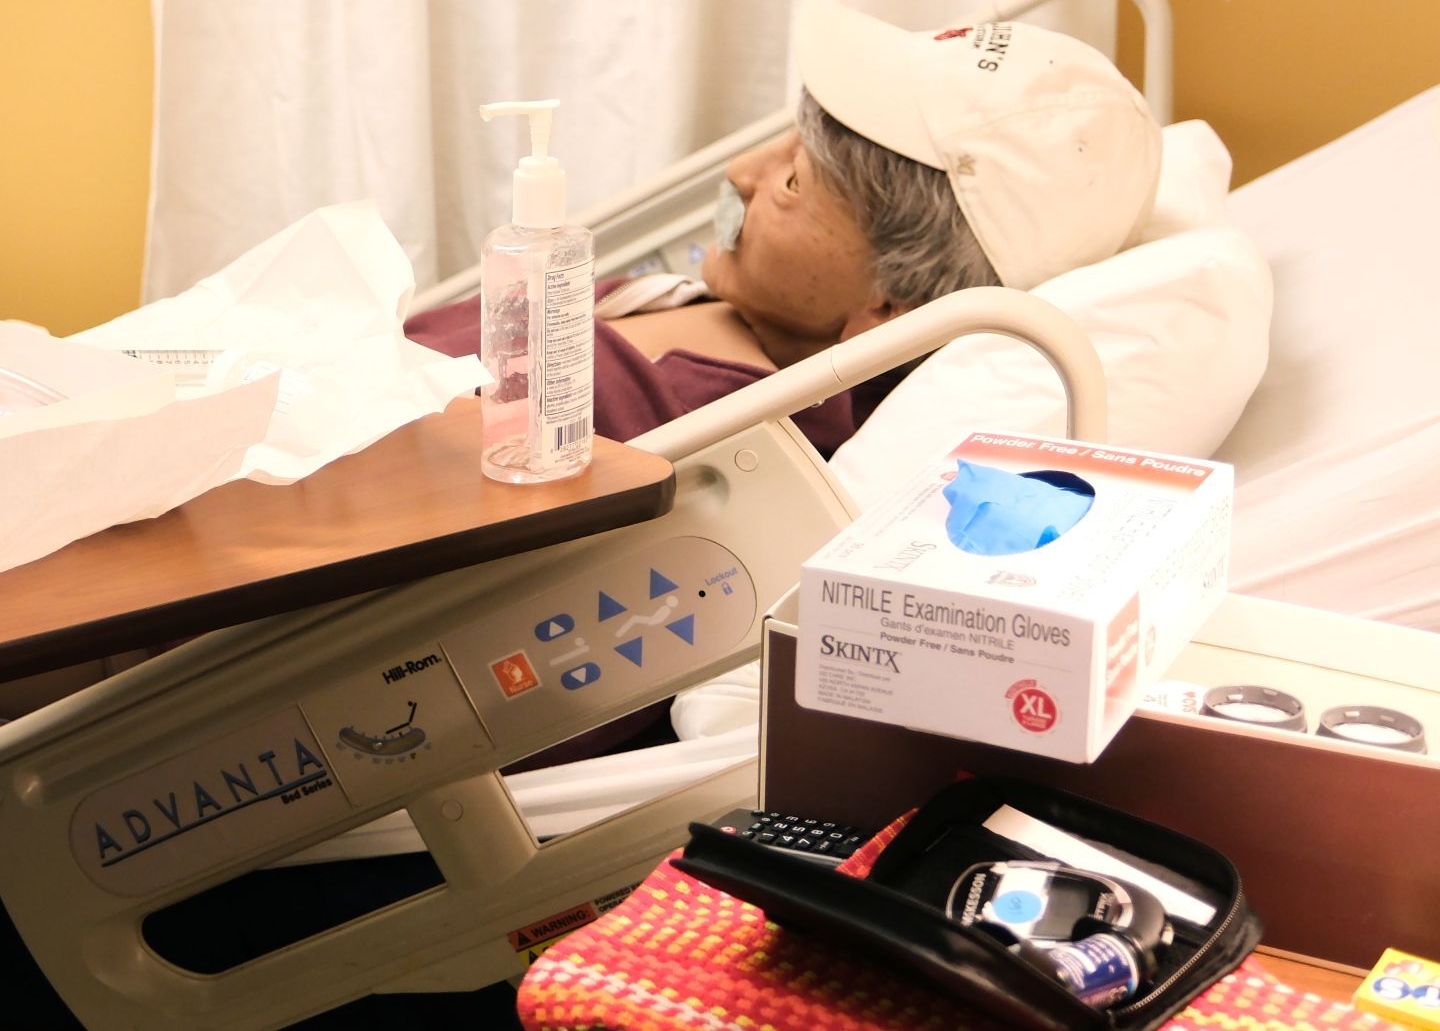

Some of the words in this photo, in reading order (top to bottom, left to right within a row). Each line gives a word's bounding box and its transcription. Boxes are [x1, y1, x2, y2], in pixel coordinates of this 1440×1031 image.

[970, 434, 1037, 449] Powder
[1038, 442, 1077, 456] Free
[1091, 450, 1137, 465] Sans
[1141, 458, 1206, 477] Poudre
[704, 567, 738, 586] Lockout
[822, 579, 893, 615] NITRILE
[903, 594, 1006, 634] Examination
[1012, 613, 1071, 648] Gloves
[880, 617, 912, 633] Gants
[915, 623, 965, 642] d'examen
[969, 633, 1015, 651] NITRILE
[880, 632, 916, 646] Powder
[920, 639, 941, 651] Free
[950, 644, 975, 658] Sans
[978, 649, 1015, 664] Poudre
[820, 634, 900, 674] SKINTX
[1020, 693, 1052, 719] XL
[95, 737, 323, 859] ADVANTA
[281, 790, 302, 805] Bed
[302, 778, 333, 797] Series
[594, 885, 631, 906] POWERED
[530, 909, 590, 940] WARNING:
